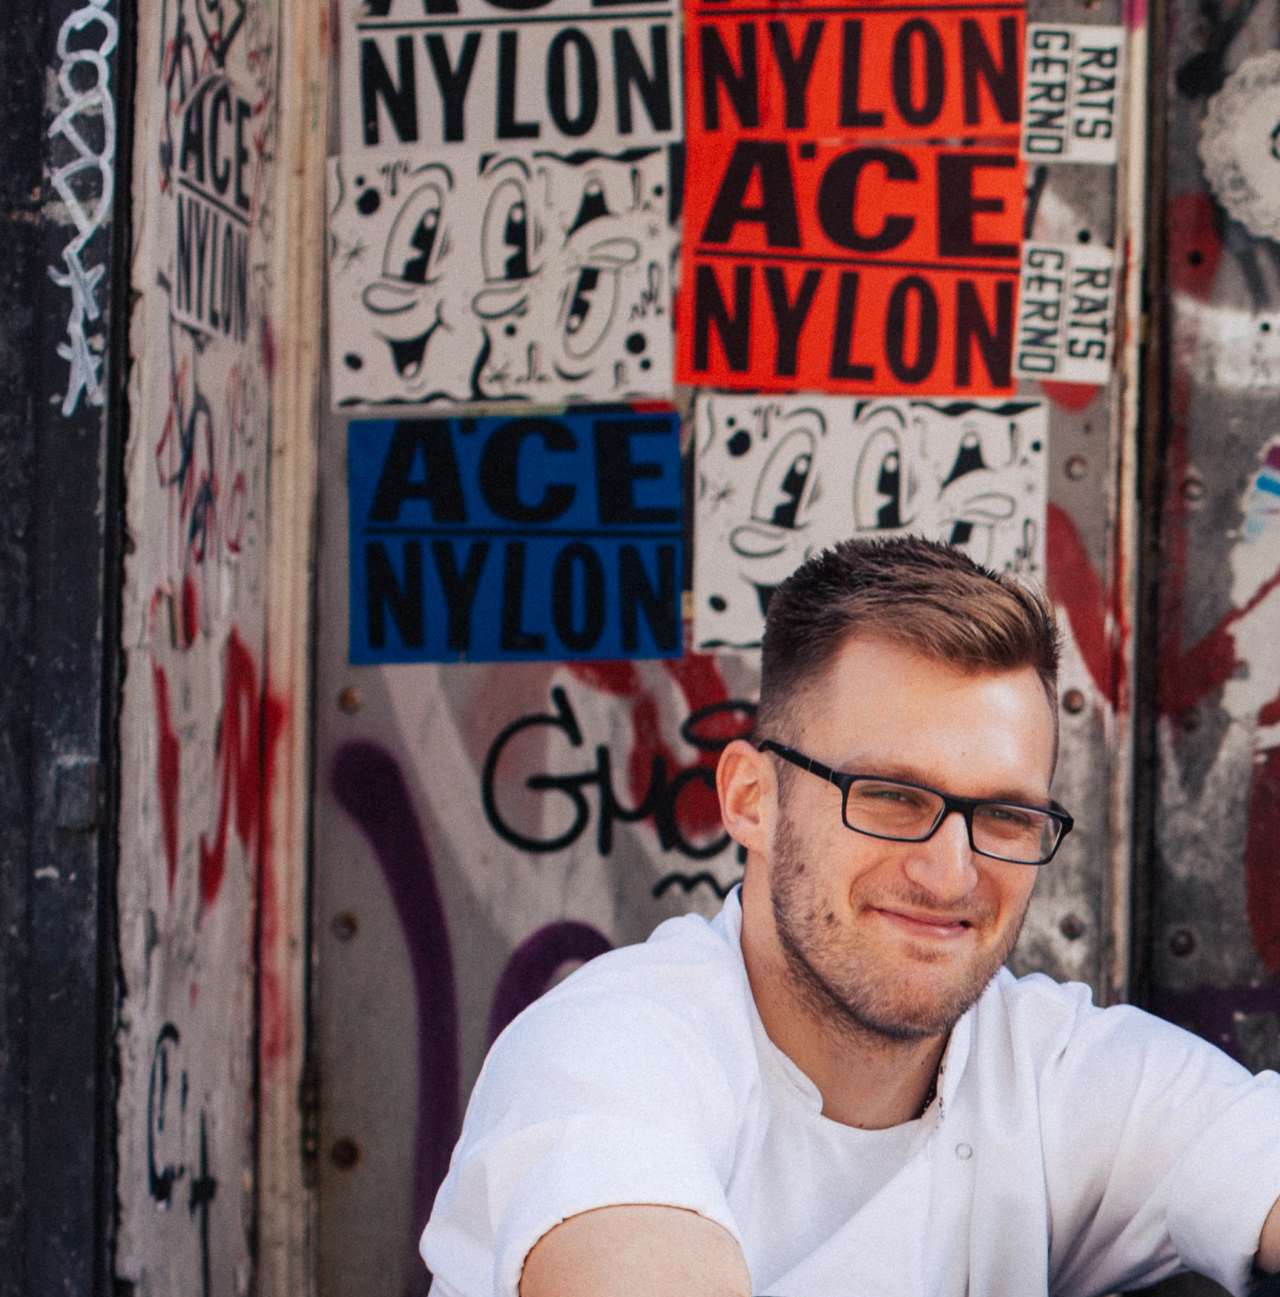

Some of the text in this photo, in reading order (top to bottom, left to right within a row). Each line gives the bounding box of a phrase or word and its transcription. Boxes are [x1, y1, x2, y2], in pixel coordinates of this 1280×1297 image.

[360, 25, 674, 146] NYLON
[698, 15, 1020, 131] NYLON
[1075, 46, 1118, 141] RATS
[179, 77, 252, 211] ACE
[698, 140, 1020, 259] ACE
[693, 263, 1015, 390] NYLON
[1068, 266, 1111, 362] RATS
[368, 416, 681, 526] ACE
[365, 540, 678, 655] NYLON
